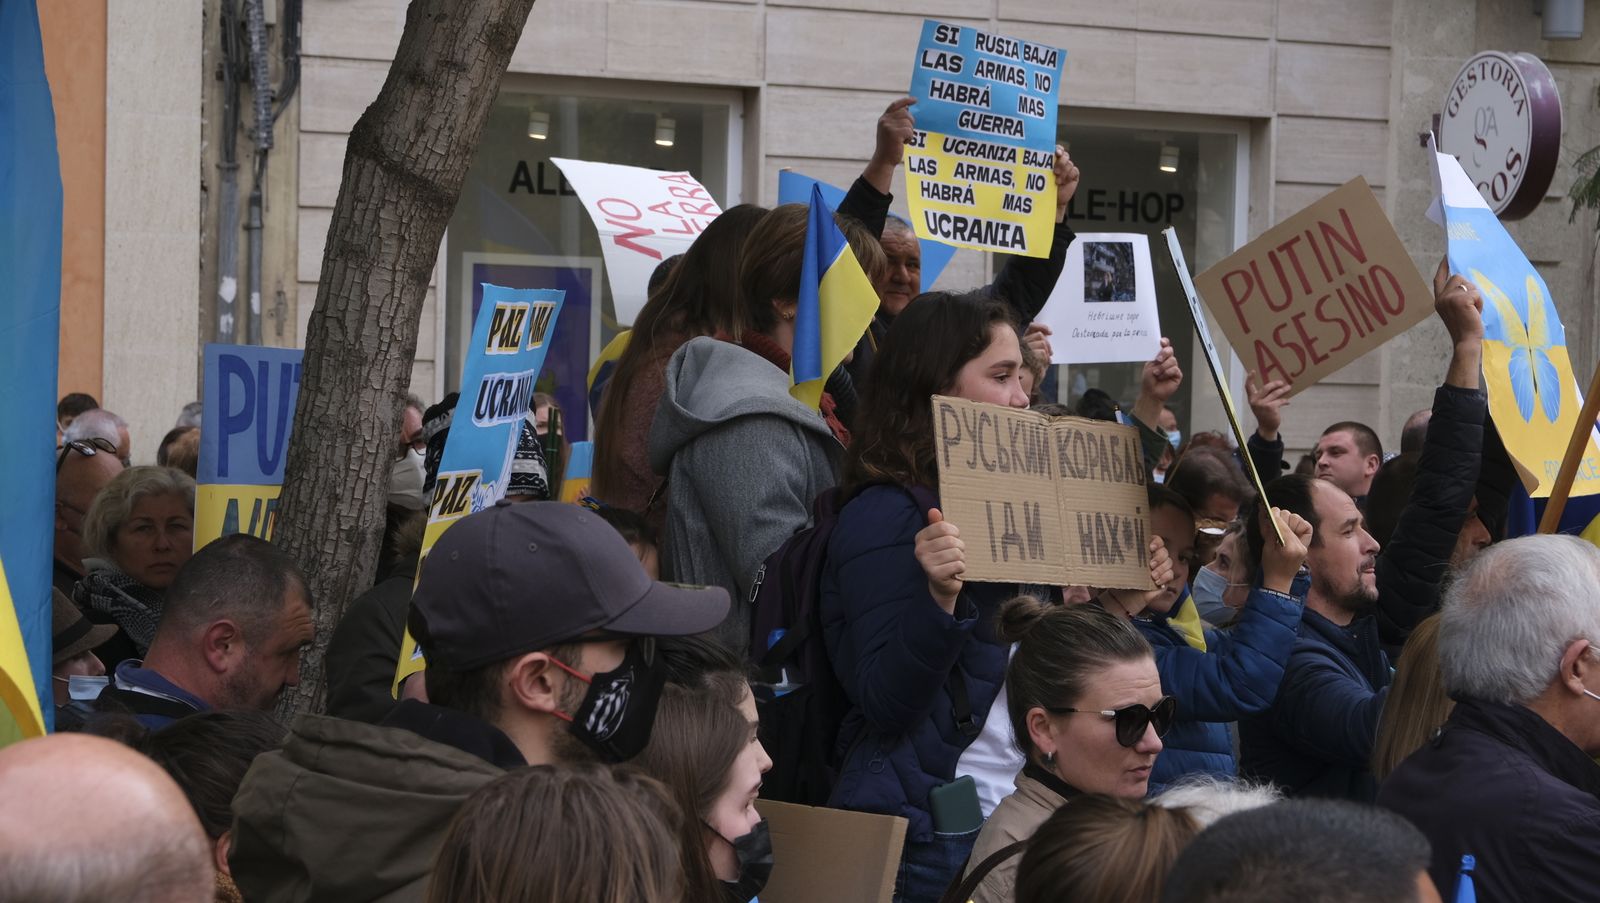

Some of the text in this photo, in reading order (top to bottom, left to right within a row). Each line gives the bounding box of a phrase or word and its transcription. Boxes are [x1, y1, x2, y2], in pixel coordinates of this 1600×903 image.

[935, 25, 1058, 68] SI RUSIA BAJA
[921, 50, 1051, 93] LAS ARMAS, NO
[1448, 61, 1525, 118] GESTORIA
[929, 80, 1045, 117] HABRÁ MAS
[958, 111, 1025, 137] GUERRA
[908, 131, 1054, 169] SI UCRANIA BAJA
[908, 156, 1046, 191] LAS ARMAS, NO
[648, 201, 694, 235] LA
[920, 180, 1033, 213] HABRÁ MAS
[597, 198, 662, 260] NO
[924, 210, 1027, 250] UCRANIA
[1221, 208, 1368, 335] PUTIN
[487, 308, 529, 349] PAZ
[1254, 264, 1406, 386] ASESINO
[1056, 428, 1145, 486] КОРАБЛЬ
[429, 475, 480, 518] PAZ
[986, 501, 1045, 562] ІДИ
